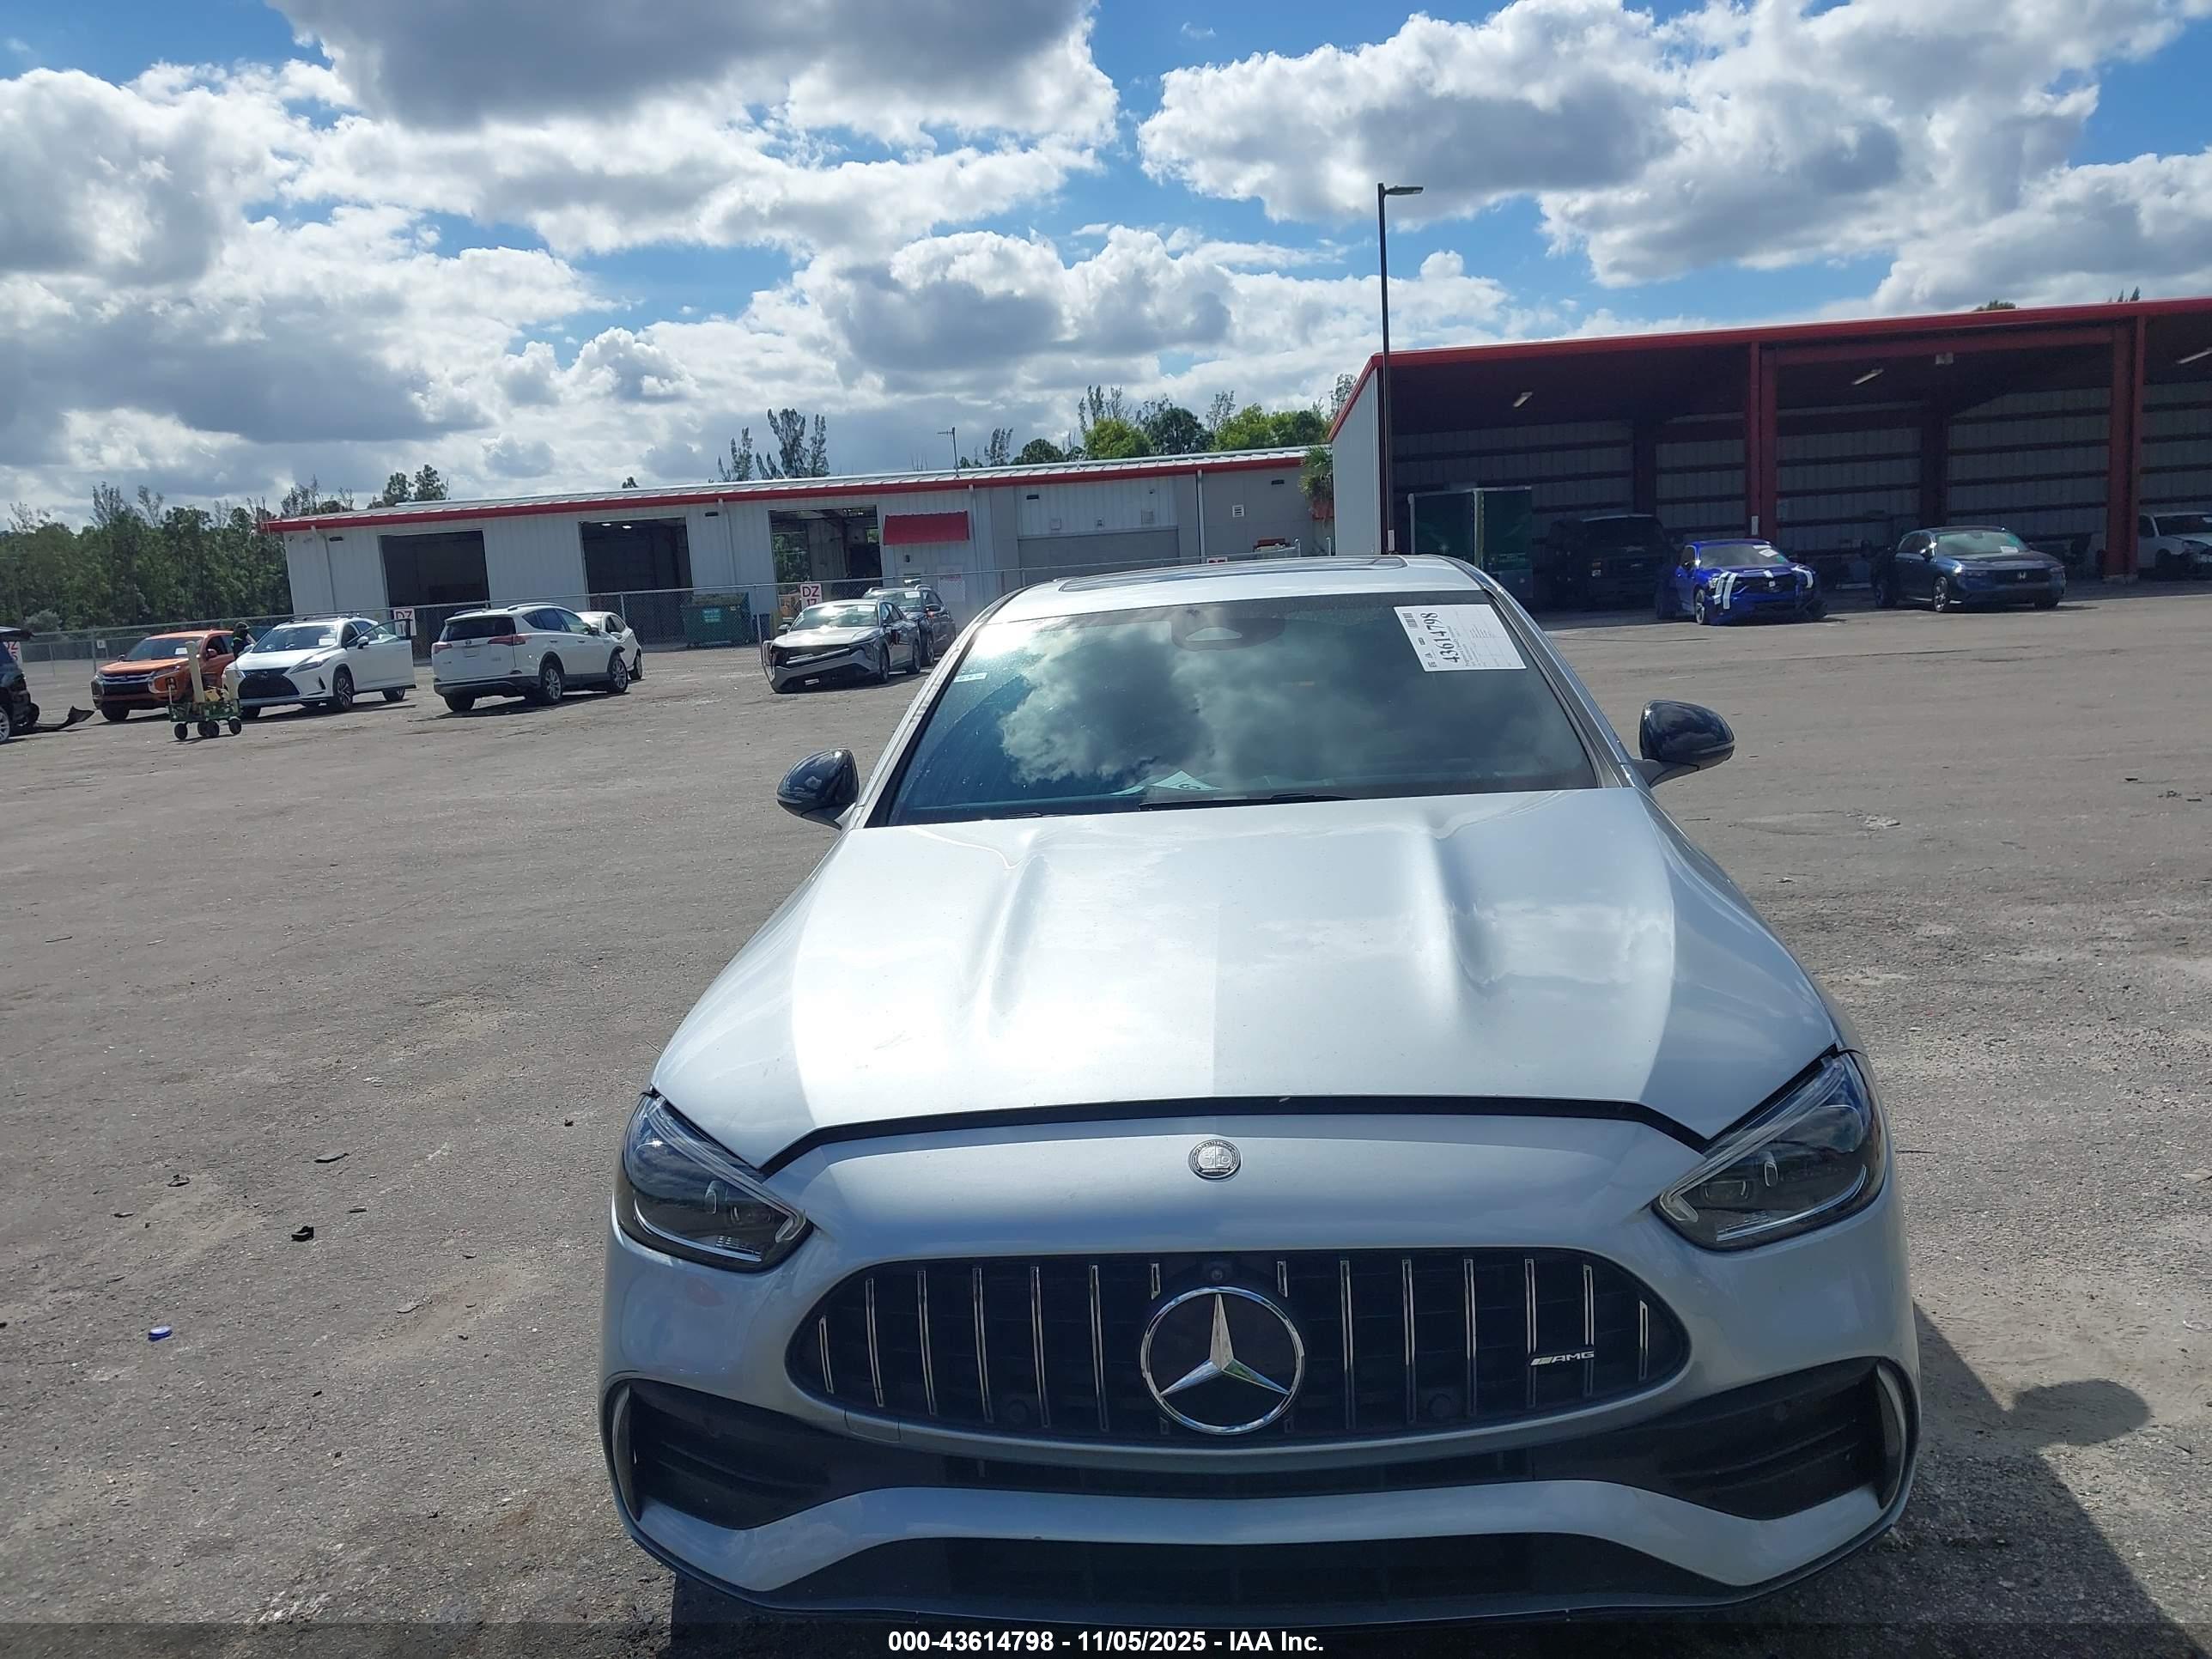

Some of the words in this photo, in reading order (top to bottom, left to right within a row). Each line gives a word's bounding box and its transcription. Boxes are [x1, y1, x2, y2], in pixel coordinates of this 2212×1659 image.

[802, 586, 820, 597] DZ
[1420, 612, 1461, 663] 43614798
[1551, 1351, 1595, 1363] AMG
